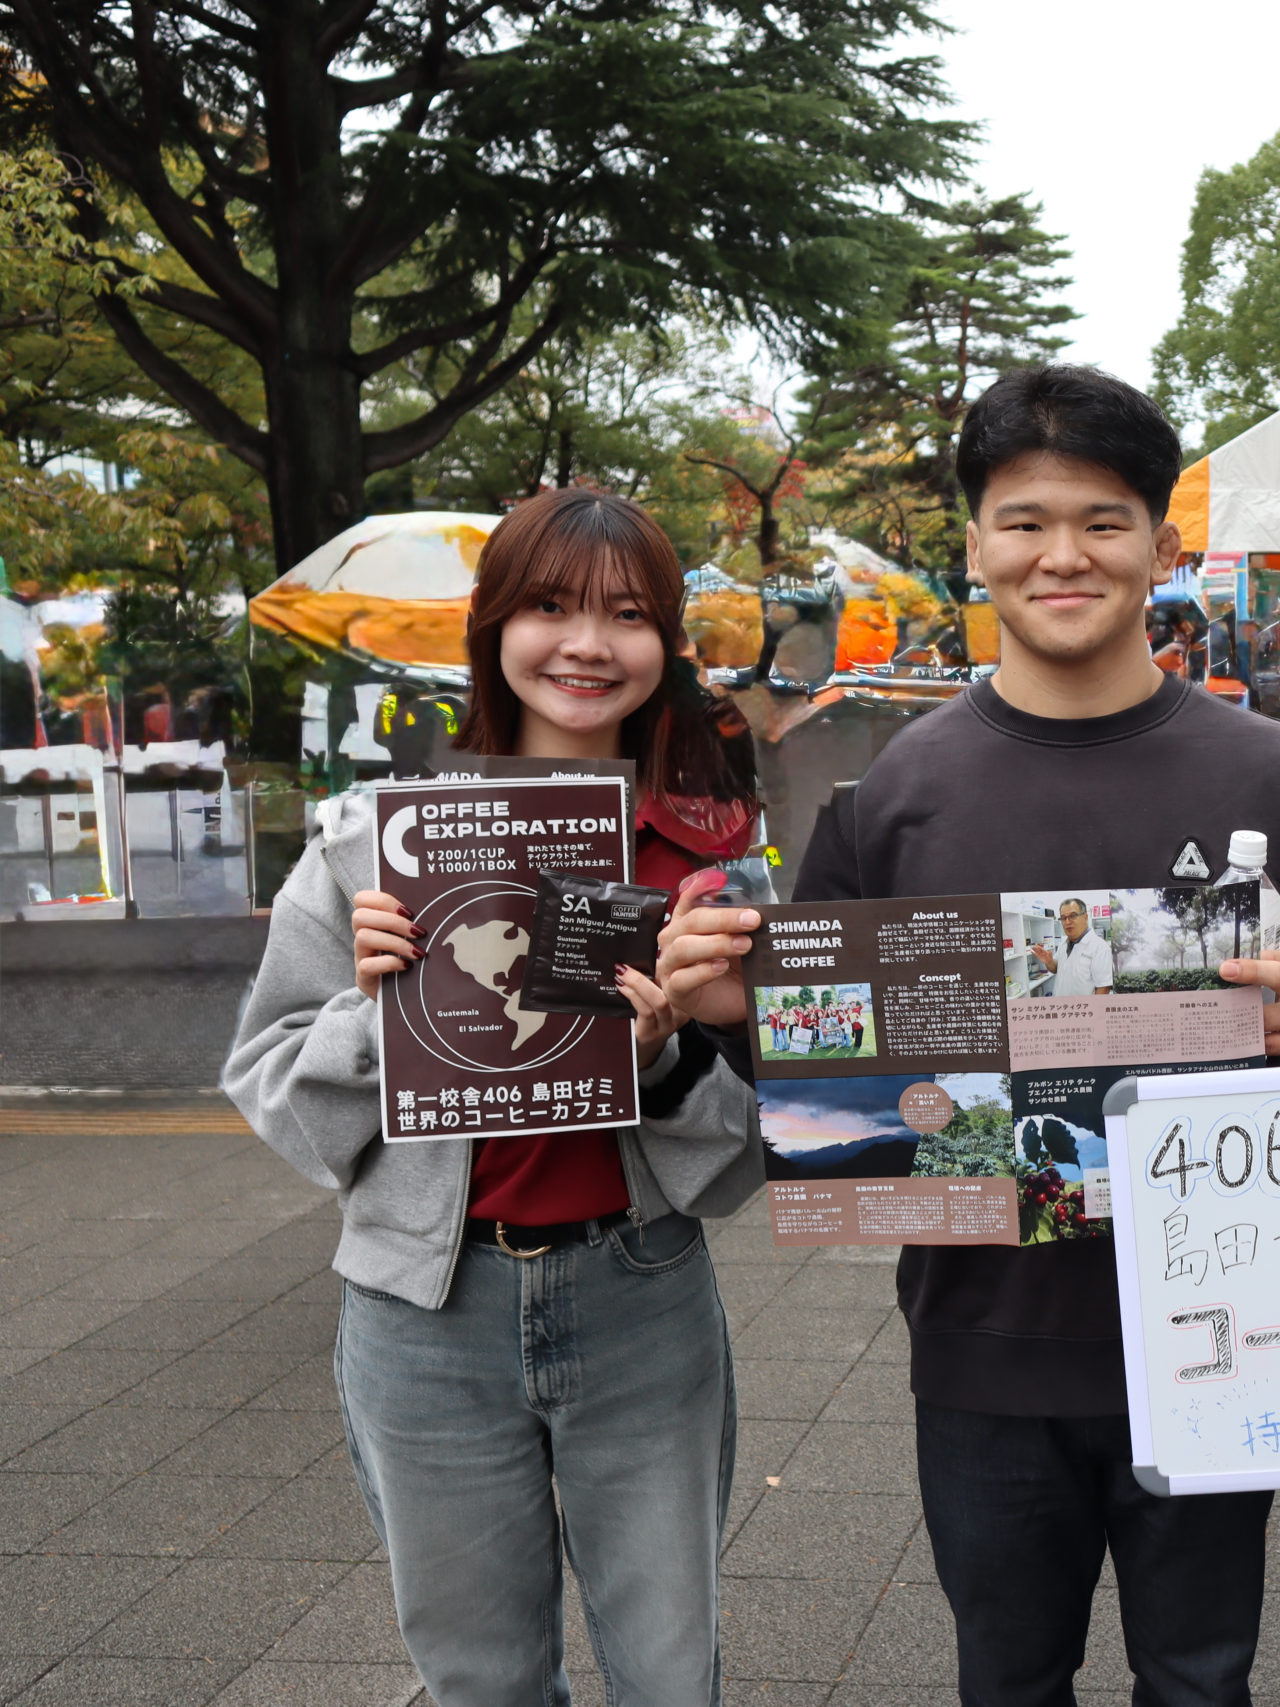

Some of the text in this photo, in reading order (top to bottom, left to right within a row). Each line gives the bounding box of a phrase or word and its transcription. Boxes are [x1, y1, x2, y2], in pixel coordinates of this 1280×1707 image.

[424, 818, 617, 840] EXPLORATION
[561, 894, 592, 915] SA
[613, 905, 639, 913] COFFEE
[912, 911, 959, 920] About us
[560, 915, 638, 933] San Miguel Antigua
[769, 919, 843, 934] SHIMADA
[556, 935, 588, 944] Guatemala
[772, 937, 843, 951] SEMINAR
[554, 950, 586, 960] San Miguel
[781, 955, 836, 969] COFFEE
[552, 966, 577, 975] Bourbon
[919, 972, 962, 983] Concept
[437, 1009, 479, 1017] Guatemala
[459, 1023, 504, 1033] El Salvador
[396, 1078, 613, 1111] 第一校舎406 島田ゼミ
